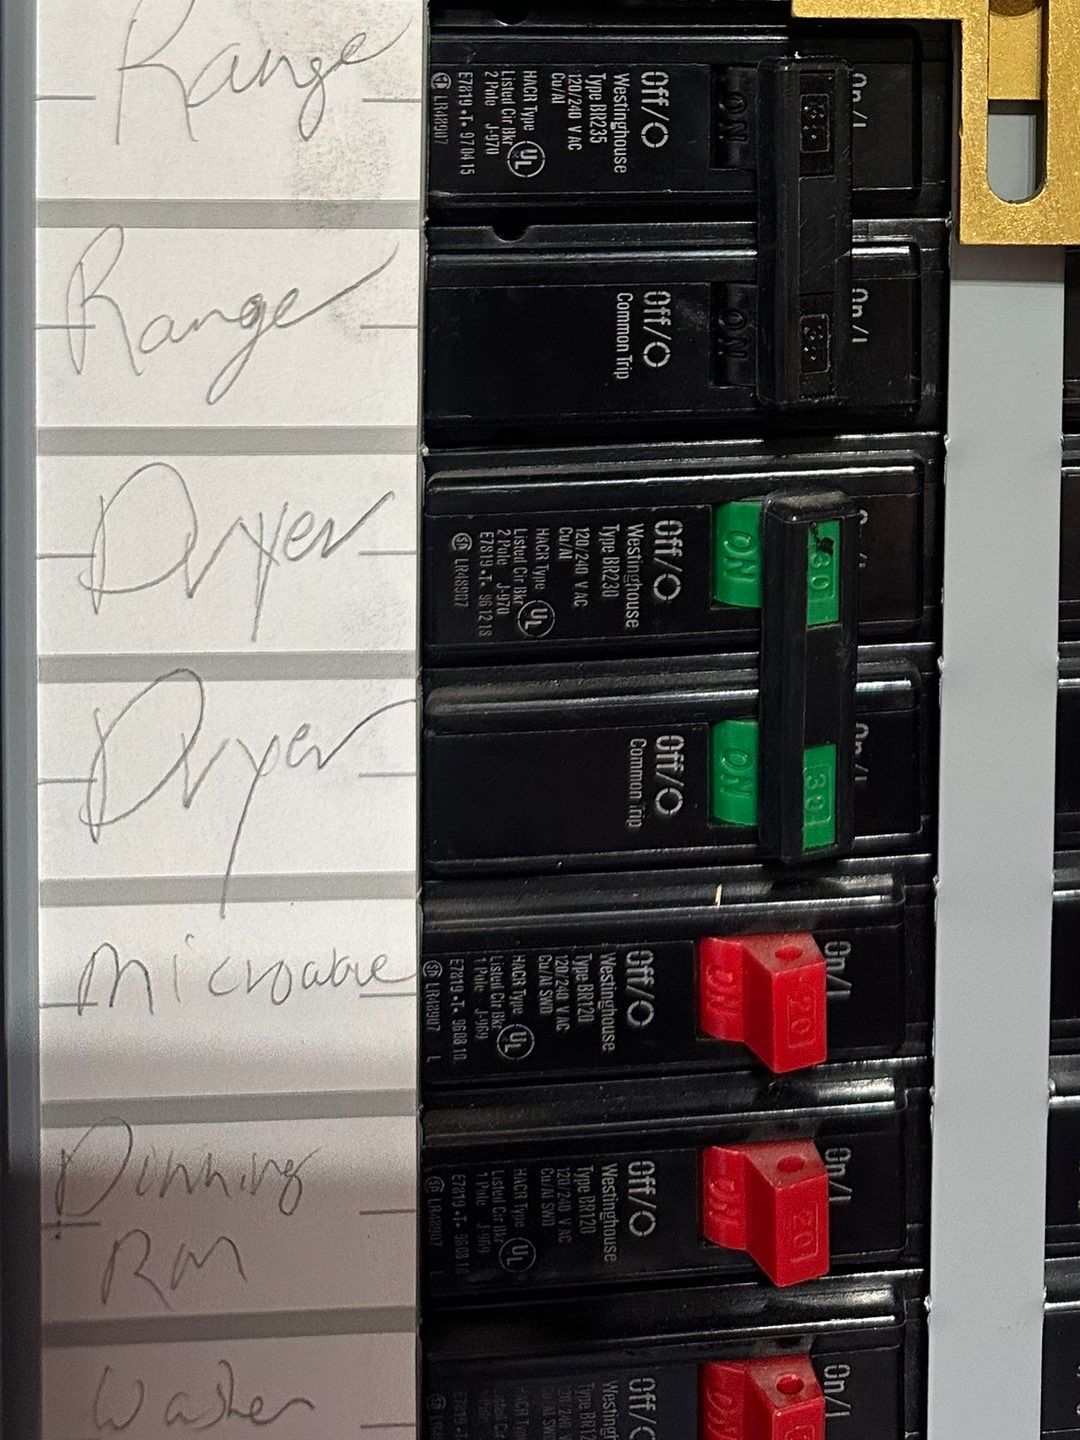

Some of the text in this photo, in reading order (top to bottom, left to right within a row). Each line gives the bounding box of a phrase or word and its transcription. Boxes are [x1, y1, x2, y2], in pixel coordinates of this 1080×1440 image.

[484, 81, 500, 106] Pole
[500, 71, 517, 146] Listed Cir Bkr
[520, 70, 538, 130] HACR Type
[566, 74, 583, 119] 120/240
[587, 73, 607, 143] Type BR235
[609, 73, 630, 173] Westinghouse
[613, 292, 633, 380] Common Trip
[496, 539, 512, 565] Pole
[512, 528, 528, 562] Listed
[532, 527, 550, 590] HACR Type
[600, 524, 620, 597] Type BR230
[624, 524, 644, 628] Westinghouse
[628, 738, 647, 800] Common
[574, 954, 595, 1021] Type BR120
[596, 952, 617, 1050] Westinghouse
[576, 1165, 597, 1234] Type BR120
[599, 1163, 619, 1261] Westinghouse
